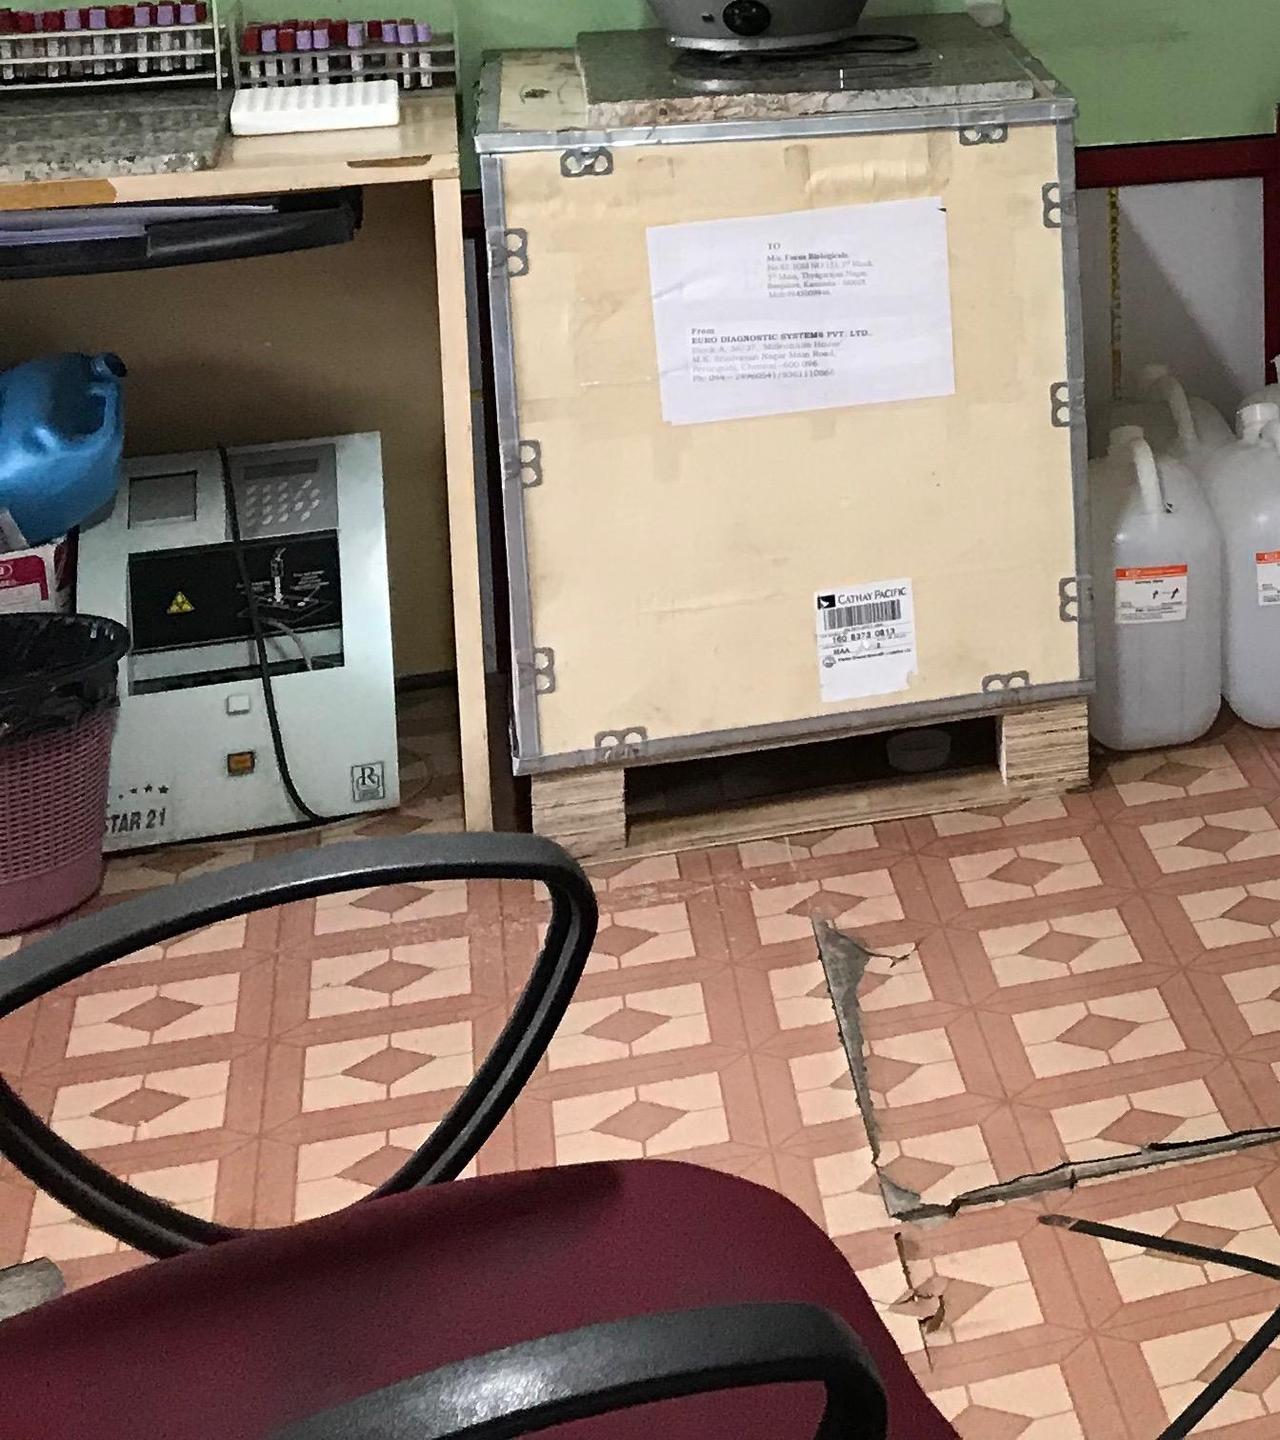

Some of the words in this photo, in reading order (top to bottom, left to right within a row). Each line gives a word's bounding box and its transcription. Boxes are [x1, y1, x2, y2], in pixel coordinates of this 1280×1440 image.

[691, 327, 715, 335] From
[691, 336, 718, 345] EURO
[720, 333, 779, 344] DIAGNOSTIC
[780, 331, 824, 341] SYSTEMS
[838, 592, 873, 605] CATHAY
[874, 587, 907, 600] PACIFIC
[146, 807, 166, 830] 21
